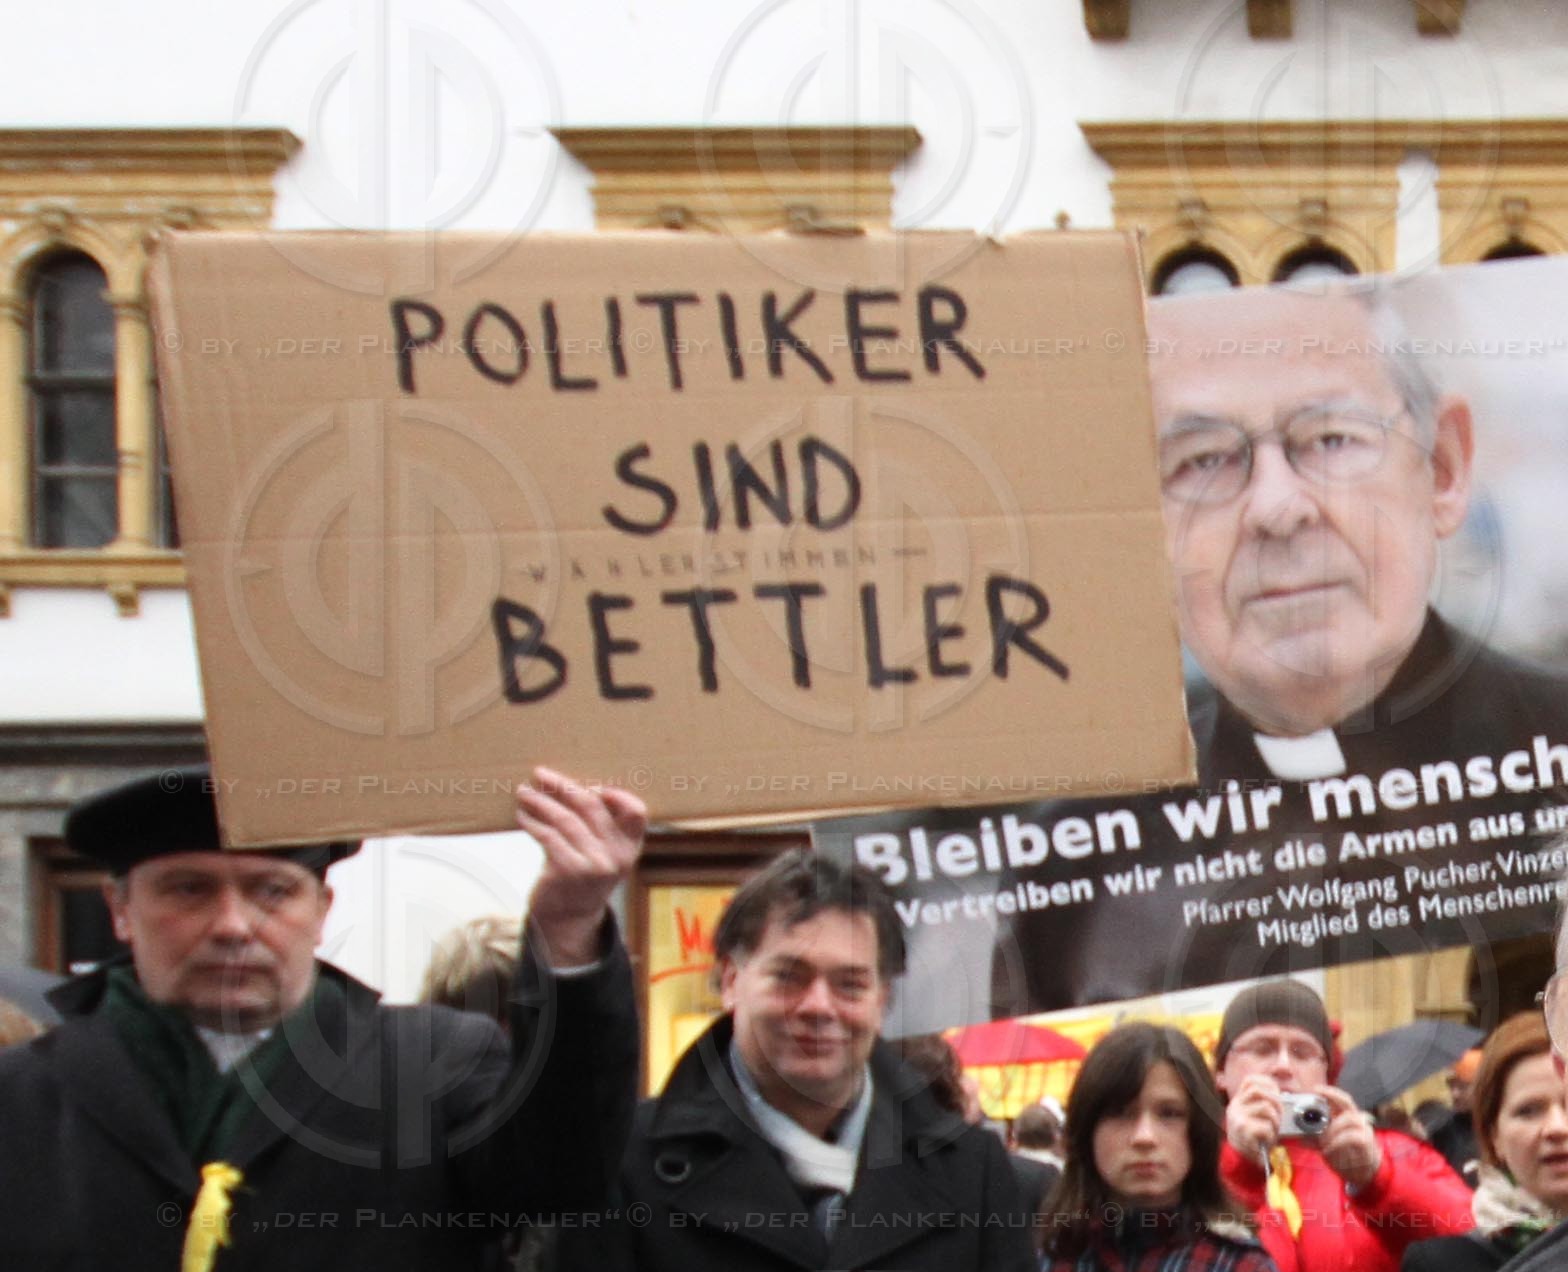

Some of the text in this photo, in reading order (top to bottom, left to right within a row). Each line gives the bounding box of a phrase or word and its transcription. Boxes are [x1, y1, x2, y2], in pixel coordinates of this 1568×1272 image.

[389, 285, 986, 394] POLITIKER
[602, 436, 862, 535] SIND
[491, 574, 1069, 705] BETTLER
[854, 808, 1142, 886] Bleiben
[1163, 779, 1282, 843] wir
[895, 877, 1094, 928] Vertreiben
[1104, 864, 1162, 897] wir
[1174, 847, 1263, 887] nicht
[1275, 838, 1327, 872] die
[1339, 820, 1458, 863] Armen
[1469, 808, 1524, 842] aus
[1183, 893, 1273, 928] Pfarrer
[1278, 872, 1398, 909] Wolfgang
[1257, 908, 1359, 949] Mitglied
[1368, 902, 1410, 931] des
